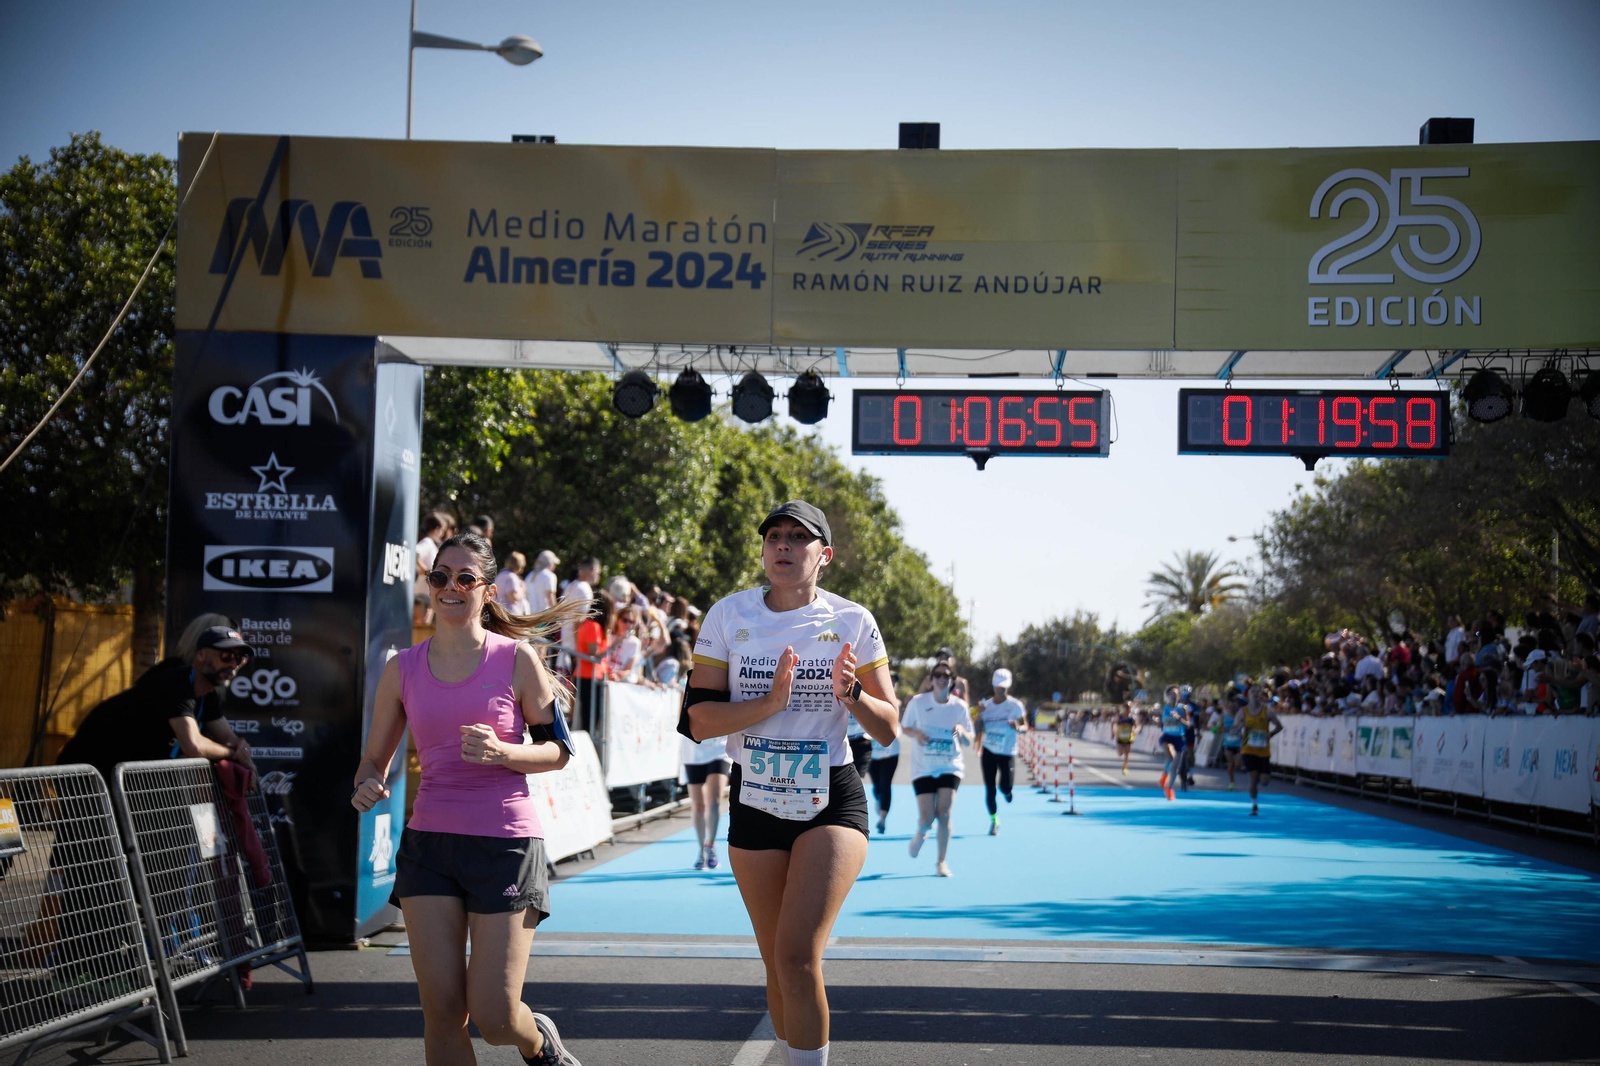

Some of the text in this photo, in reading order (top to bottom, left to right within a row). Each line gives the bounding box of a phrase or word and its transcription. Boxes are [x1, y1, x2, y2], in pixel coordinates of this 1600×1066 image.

[388, 206, 433, 237] 25
[467, 207, 767, 245] Medio Maratón
[1308, 166, 1482, 284] 25
[872, 225, 935, 239] RFEA
[388, 237, 433, 249] EDICIÓN
[865, 240, 928, 251] SERIES
[860, 253, 965, 262] RUTA RUNNING
[464, 245, 767, 290] Almería 2024
[792, 269, 1102, 294] RAMÓN RUIZ ANDÚJAR
[1308, 289, 1481, 326] EDICIÓN
[208, 385, 311, 425] CASI
[893, 395, 1097, 448] 01:06:55
[1222, 395, 1436, 449] 01:19:58
[204, 492, 338, 511] ESTRELLA
[235, 510, 307, 520] DE LEVANTE
[222, 559, 318, 579] IKEA
[241, 618, 291, 630] Barceló
[241, 632, 276, 644] Cabo
[276, 632, 292, 645] de
[740, 656, 777, 667] Medio
[796, 669, 833, 680] 2024
[230, 669, 297, 706] ego
[740, 681, 834, 690] RAMÓN ANDÚJAR
[750, 750, 821, 779] 5174
[769, 776, 796, 785] MARTA
